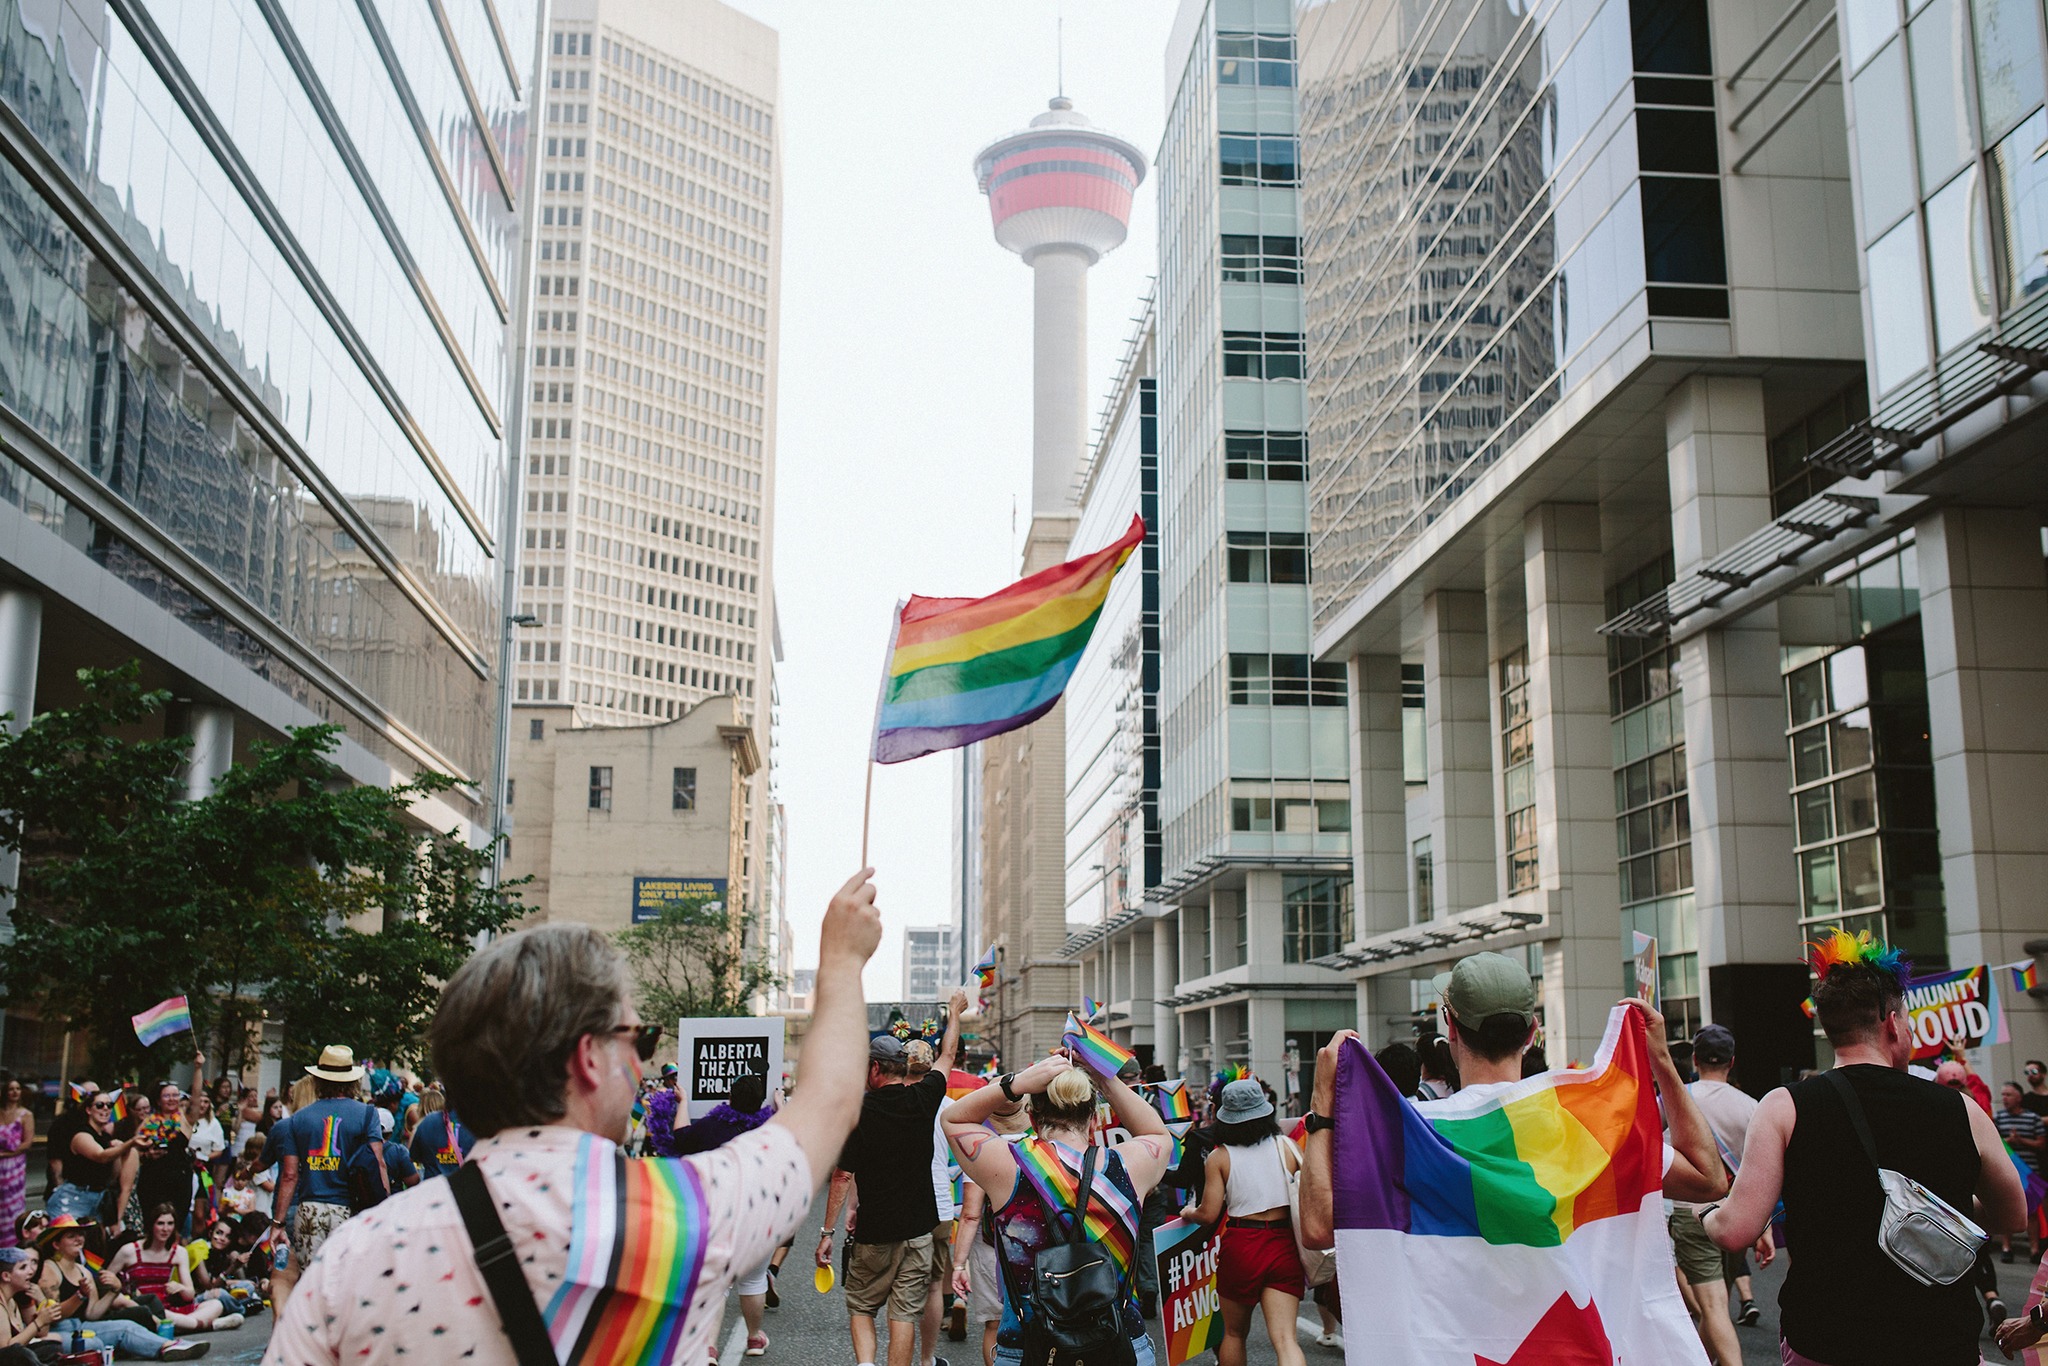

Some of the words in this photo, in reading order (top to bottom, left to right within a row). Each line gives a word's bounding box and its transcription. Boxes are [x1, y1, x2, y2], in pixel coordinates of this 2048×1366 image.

[639, 882, 682, 890] LAKESIDE
[684, 883, 714, 891] LIVING
[639, 891, 663, 899] ONLY
[699, 1043, 762, 1060] ALBERTA
[699, 1061, 761, 1077] THEATR
[698, 1078, 734, 1094] PROJ
[1168, 1235, 1221, 1293] #Prid
